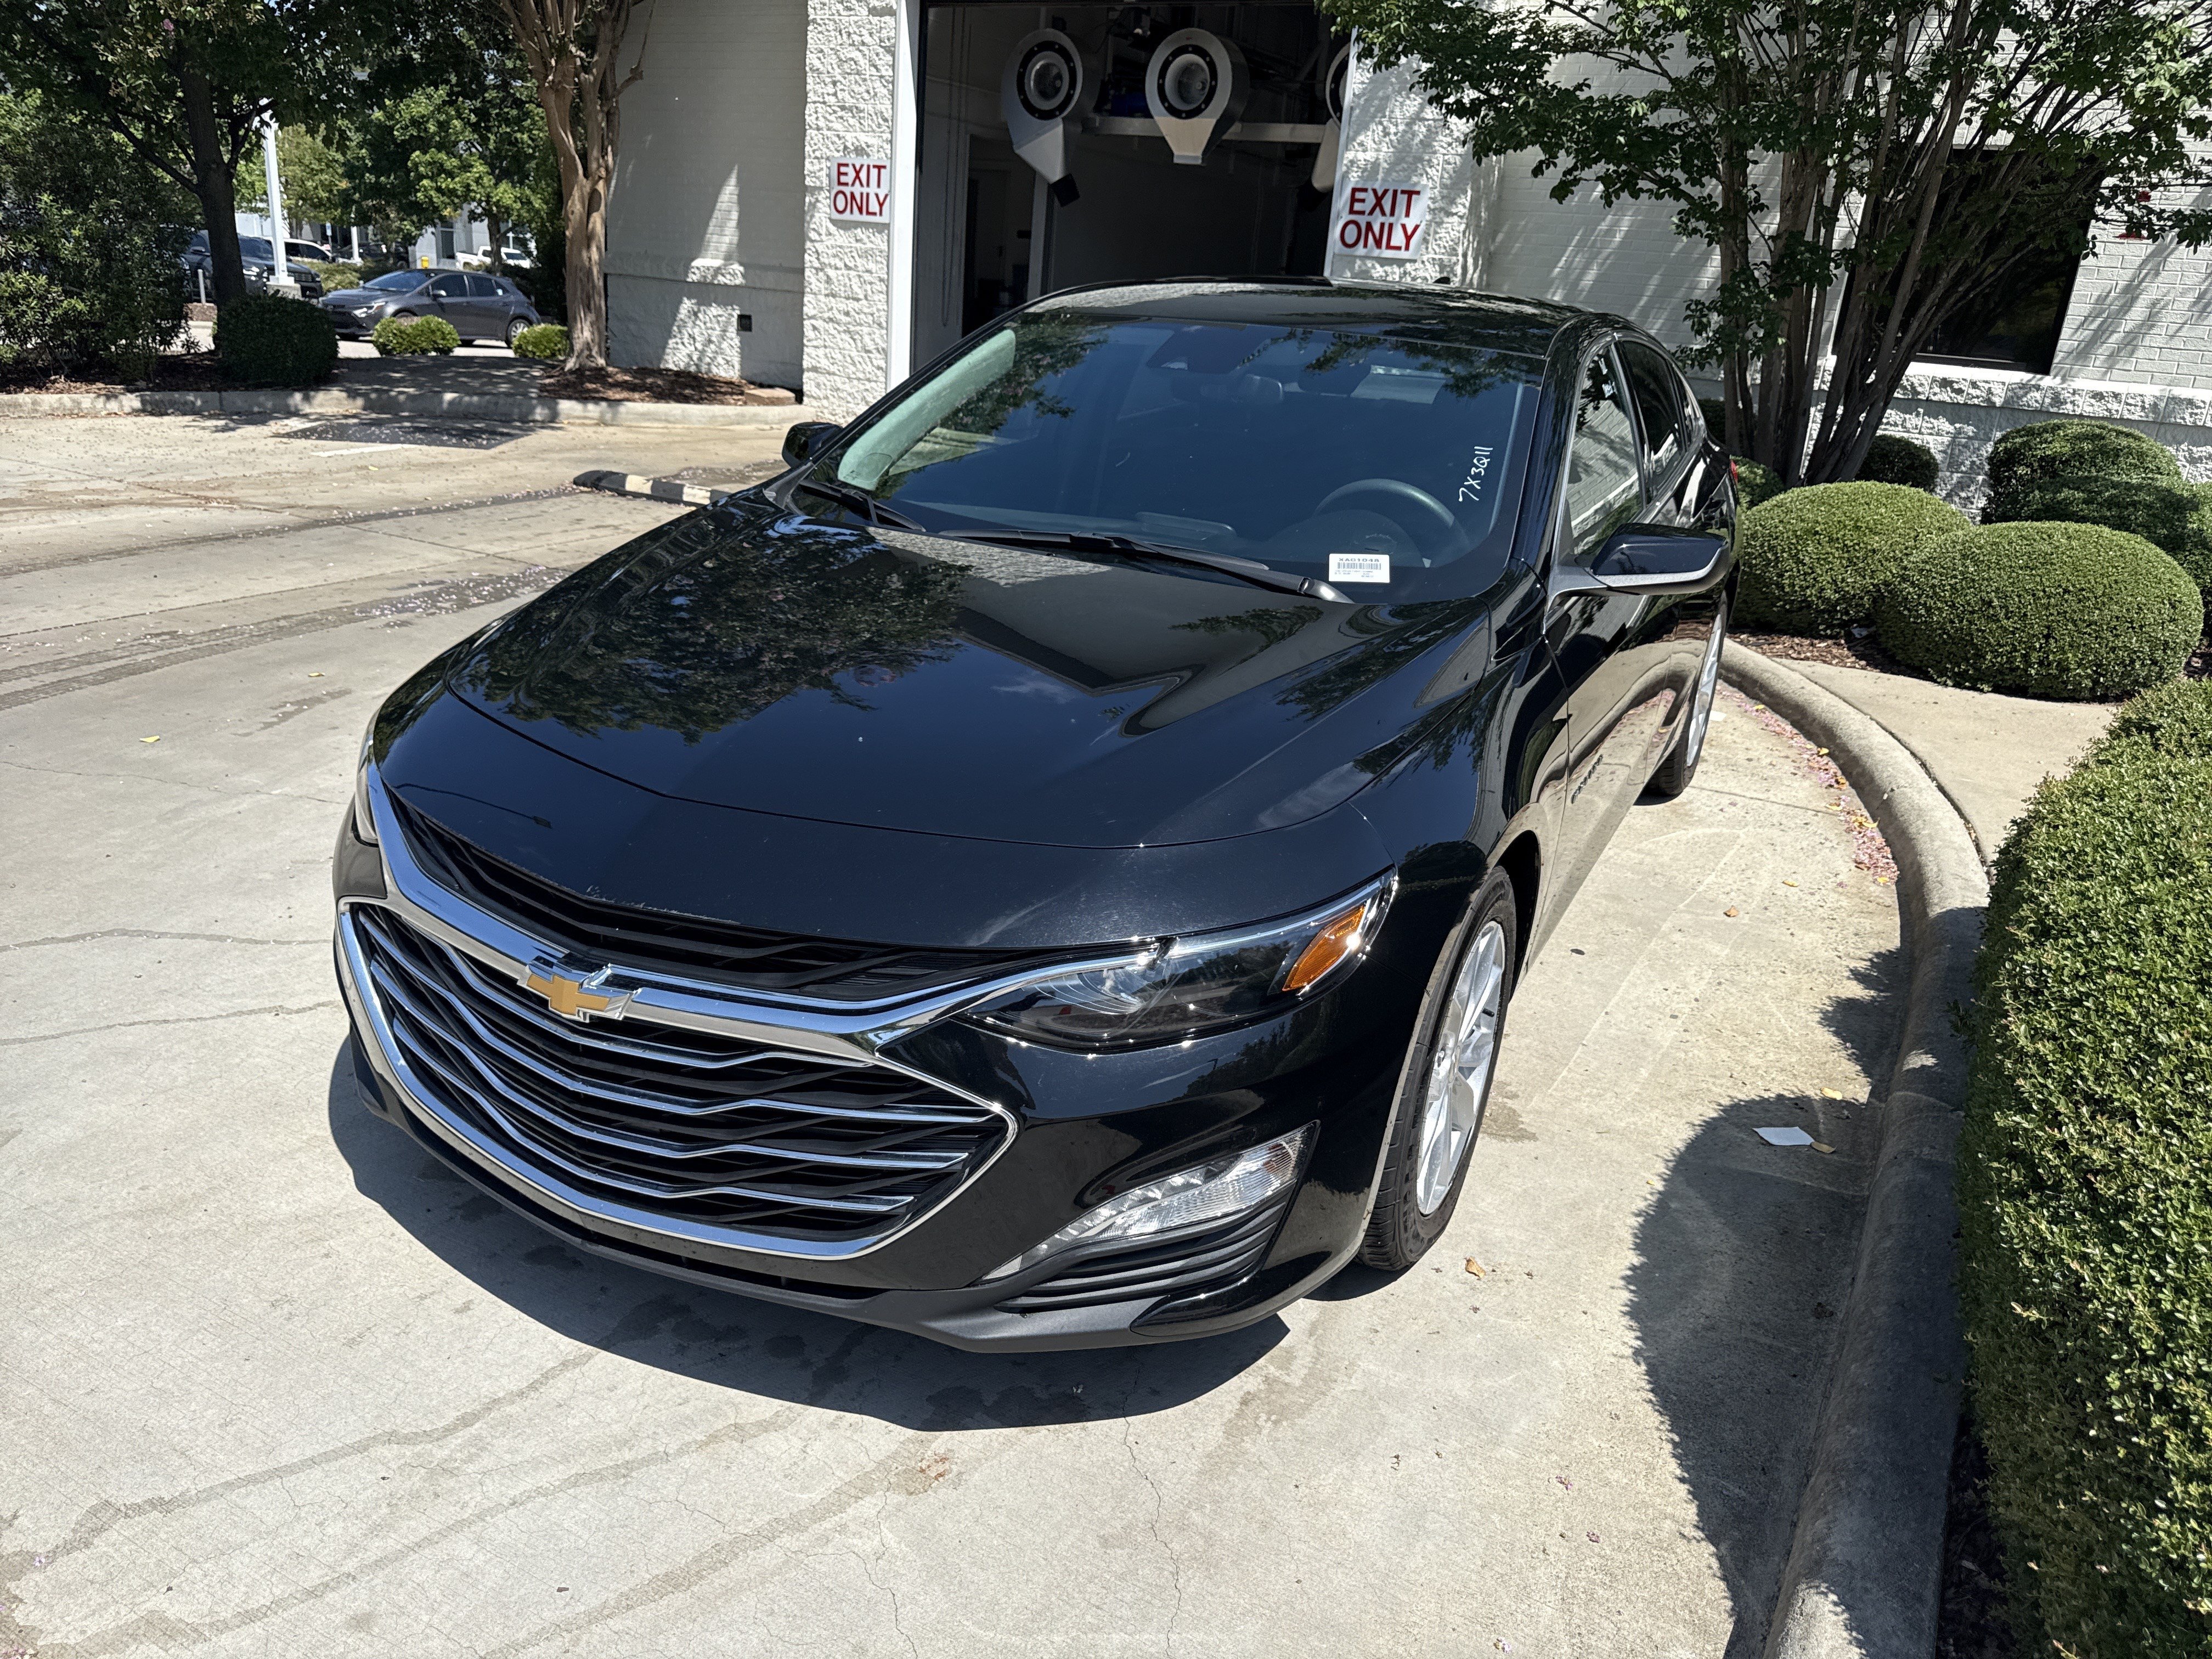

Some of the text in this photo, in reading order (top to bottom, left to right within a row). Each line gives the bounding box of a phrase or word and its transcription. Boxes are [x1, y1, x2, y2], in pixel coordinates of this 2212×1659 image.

[837, 162, 887, 189] EXIT
[833, 190, 889, 217] ONLY
[1348, 187, 1421, 218] EXIT
[1340, 219, 1421, 252] ONLY
